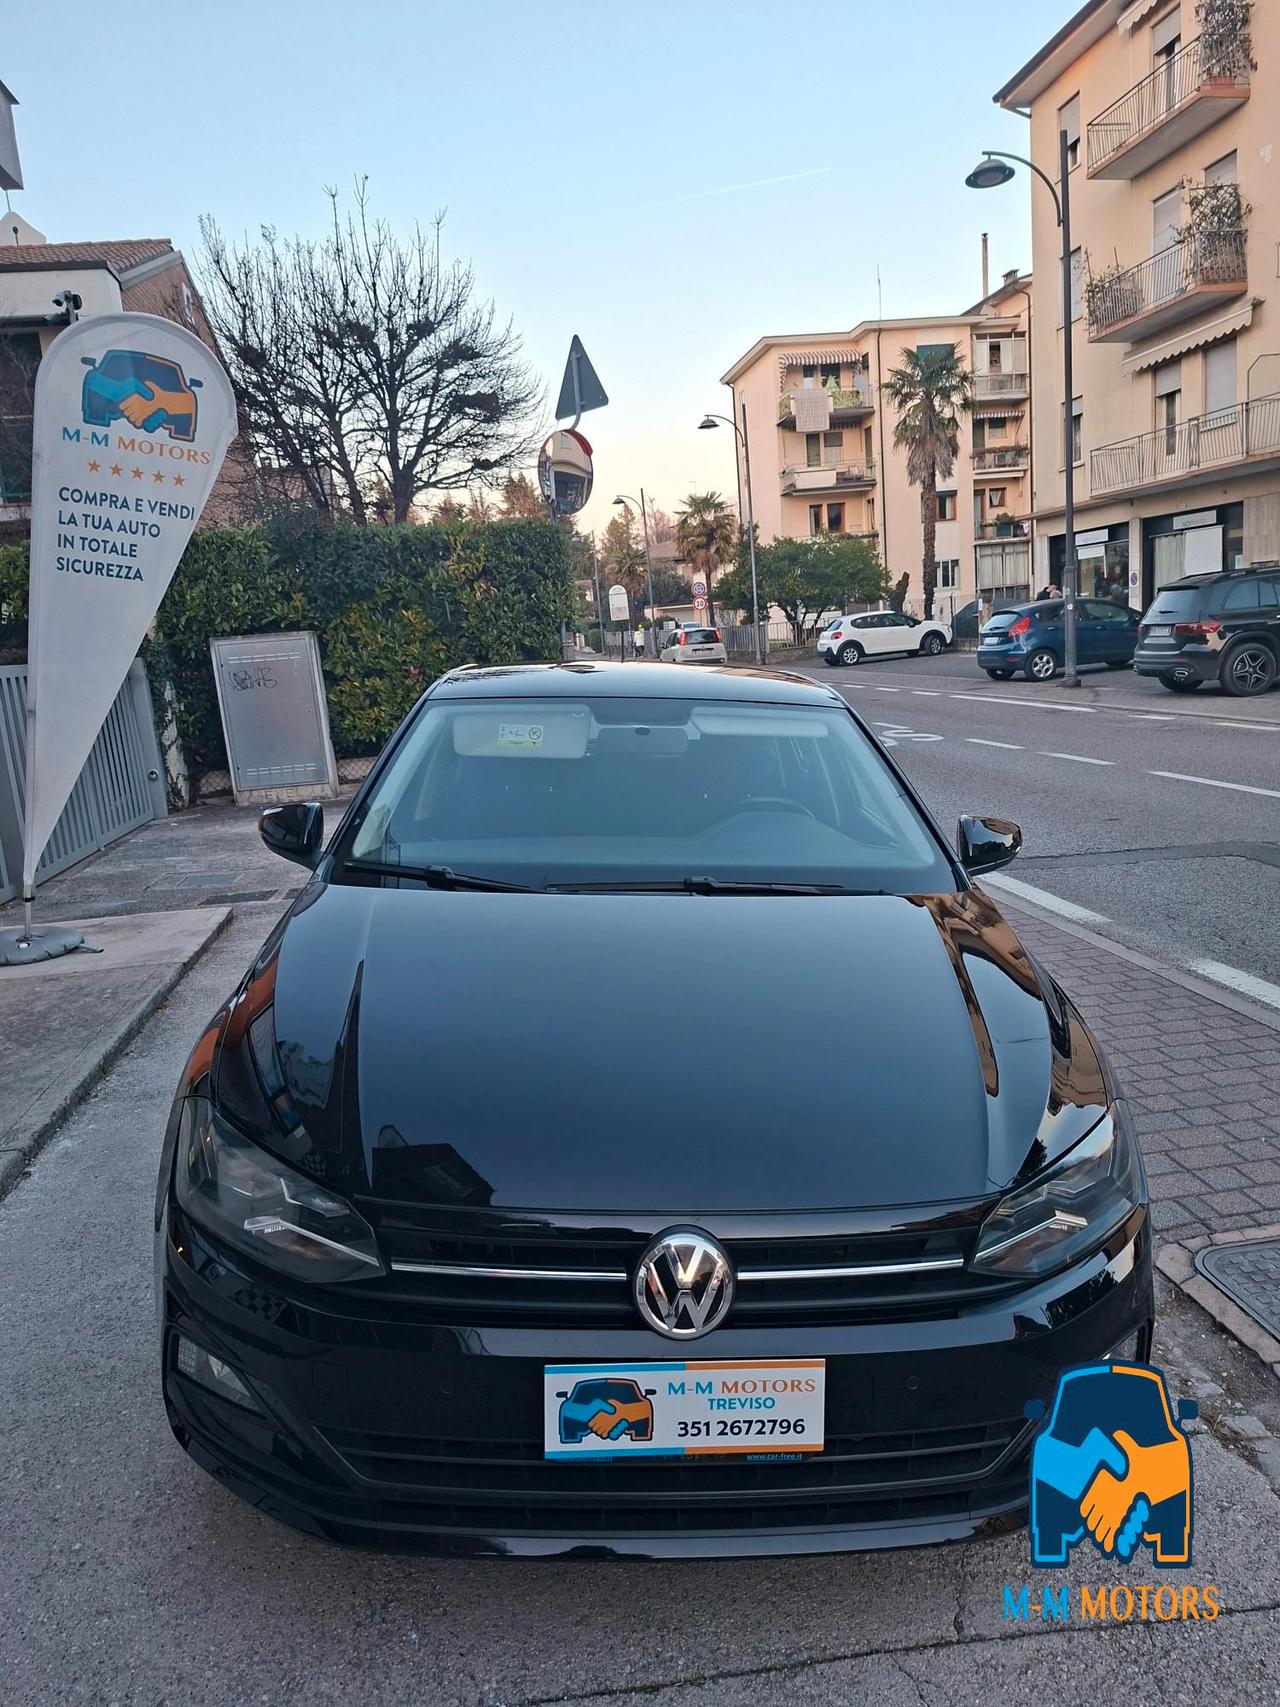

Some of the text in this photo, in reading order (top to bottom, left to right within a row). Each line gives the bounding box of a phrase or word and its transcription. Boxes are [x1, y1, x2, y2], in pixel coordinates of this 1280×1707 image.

[62, 426, 211, 465] M-M MOTORS
[58, 486, 195, 520] COMPRA E VENDI
[58, 510, 161, 538] LA TUA AUTO
[57, 533, 138, 558] IN TOTALE
[56, 556, 144, 581] SICUREZZA
[668, 1378, 816, 1395] M-M MOTORS
[708, 1397, 776, 1410] TREVISO
[677, 1418, 806, 1437] 351 2672796
